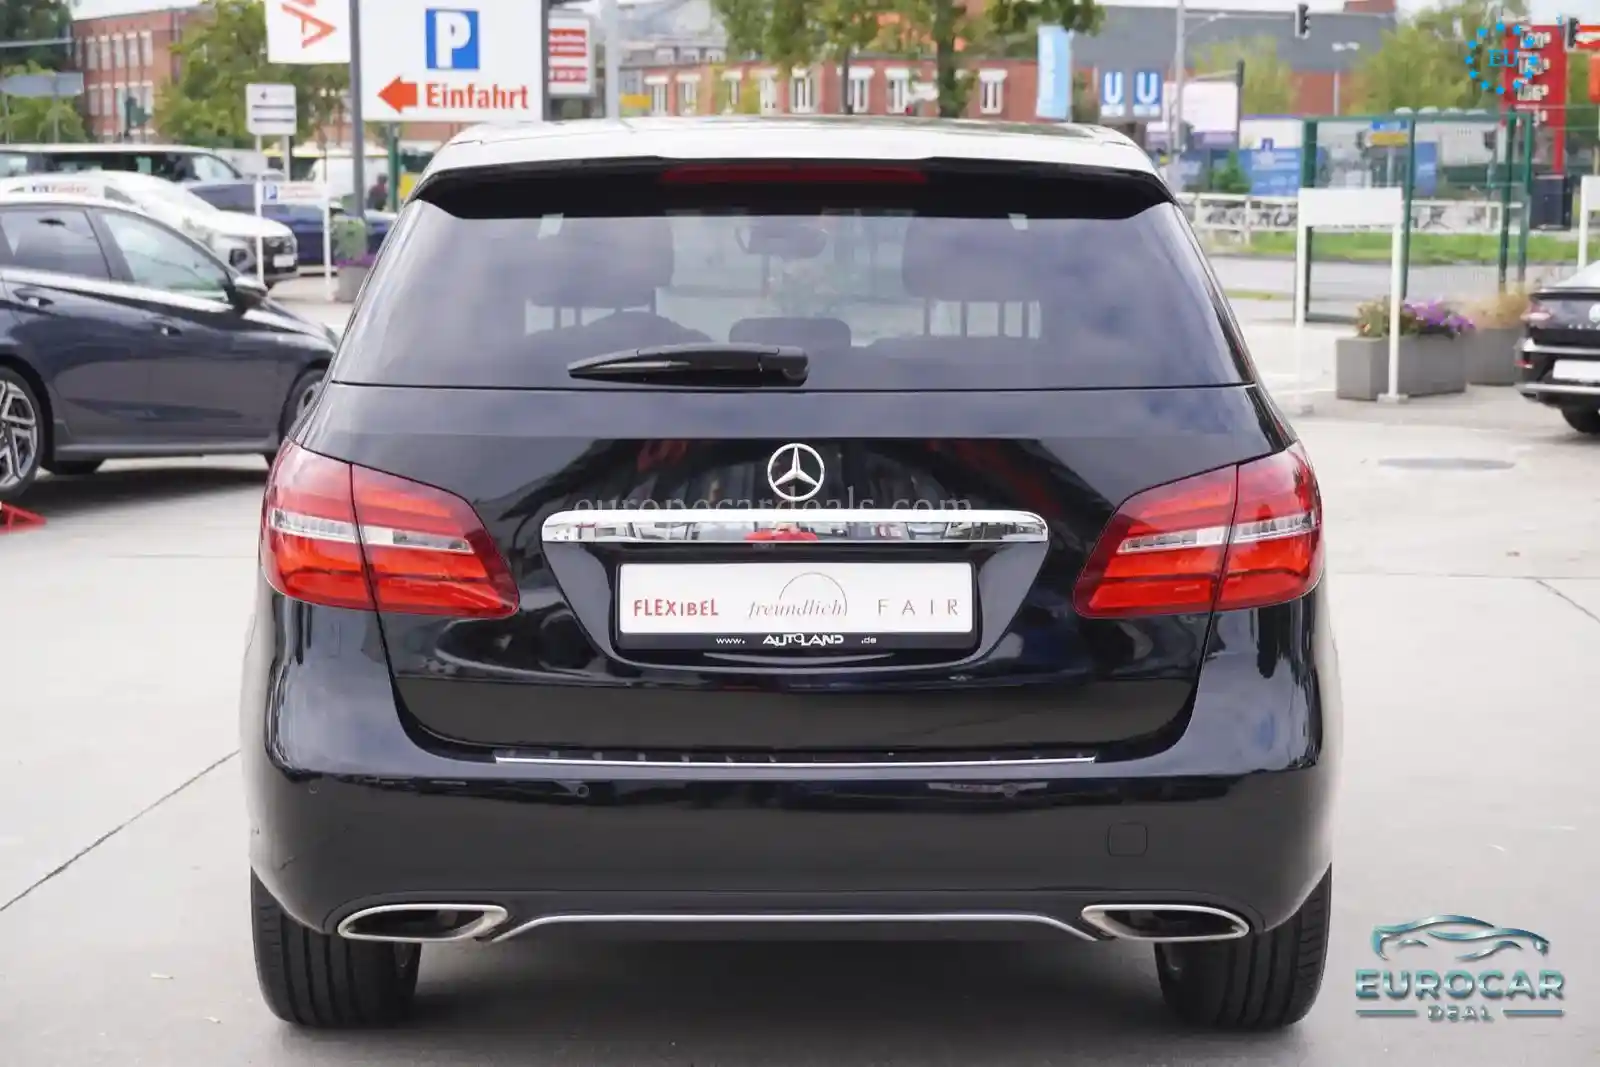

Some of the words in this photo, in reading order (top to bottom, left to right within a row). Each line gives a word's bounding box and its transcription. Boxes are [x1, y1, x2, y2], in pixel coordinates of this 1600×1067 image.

[434, 11, 471, 68] P
[425, 83, 529, 109] Einfahrt
[1104, 71, 1123, 104] U
[1136, 71, 1158, 104] U
[633, 599, 720, 617] FLEXIBEL
[748, 600, 842, 618] freundlich
[877, 599, 960, 616] FAIR
[715, 636, 747, 645] www.
[762, 633, 844, 646] AUTOLAND
